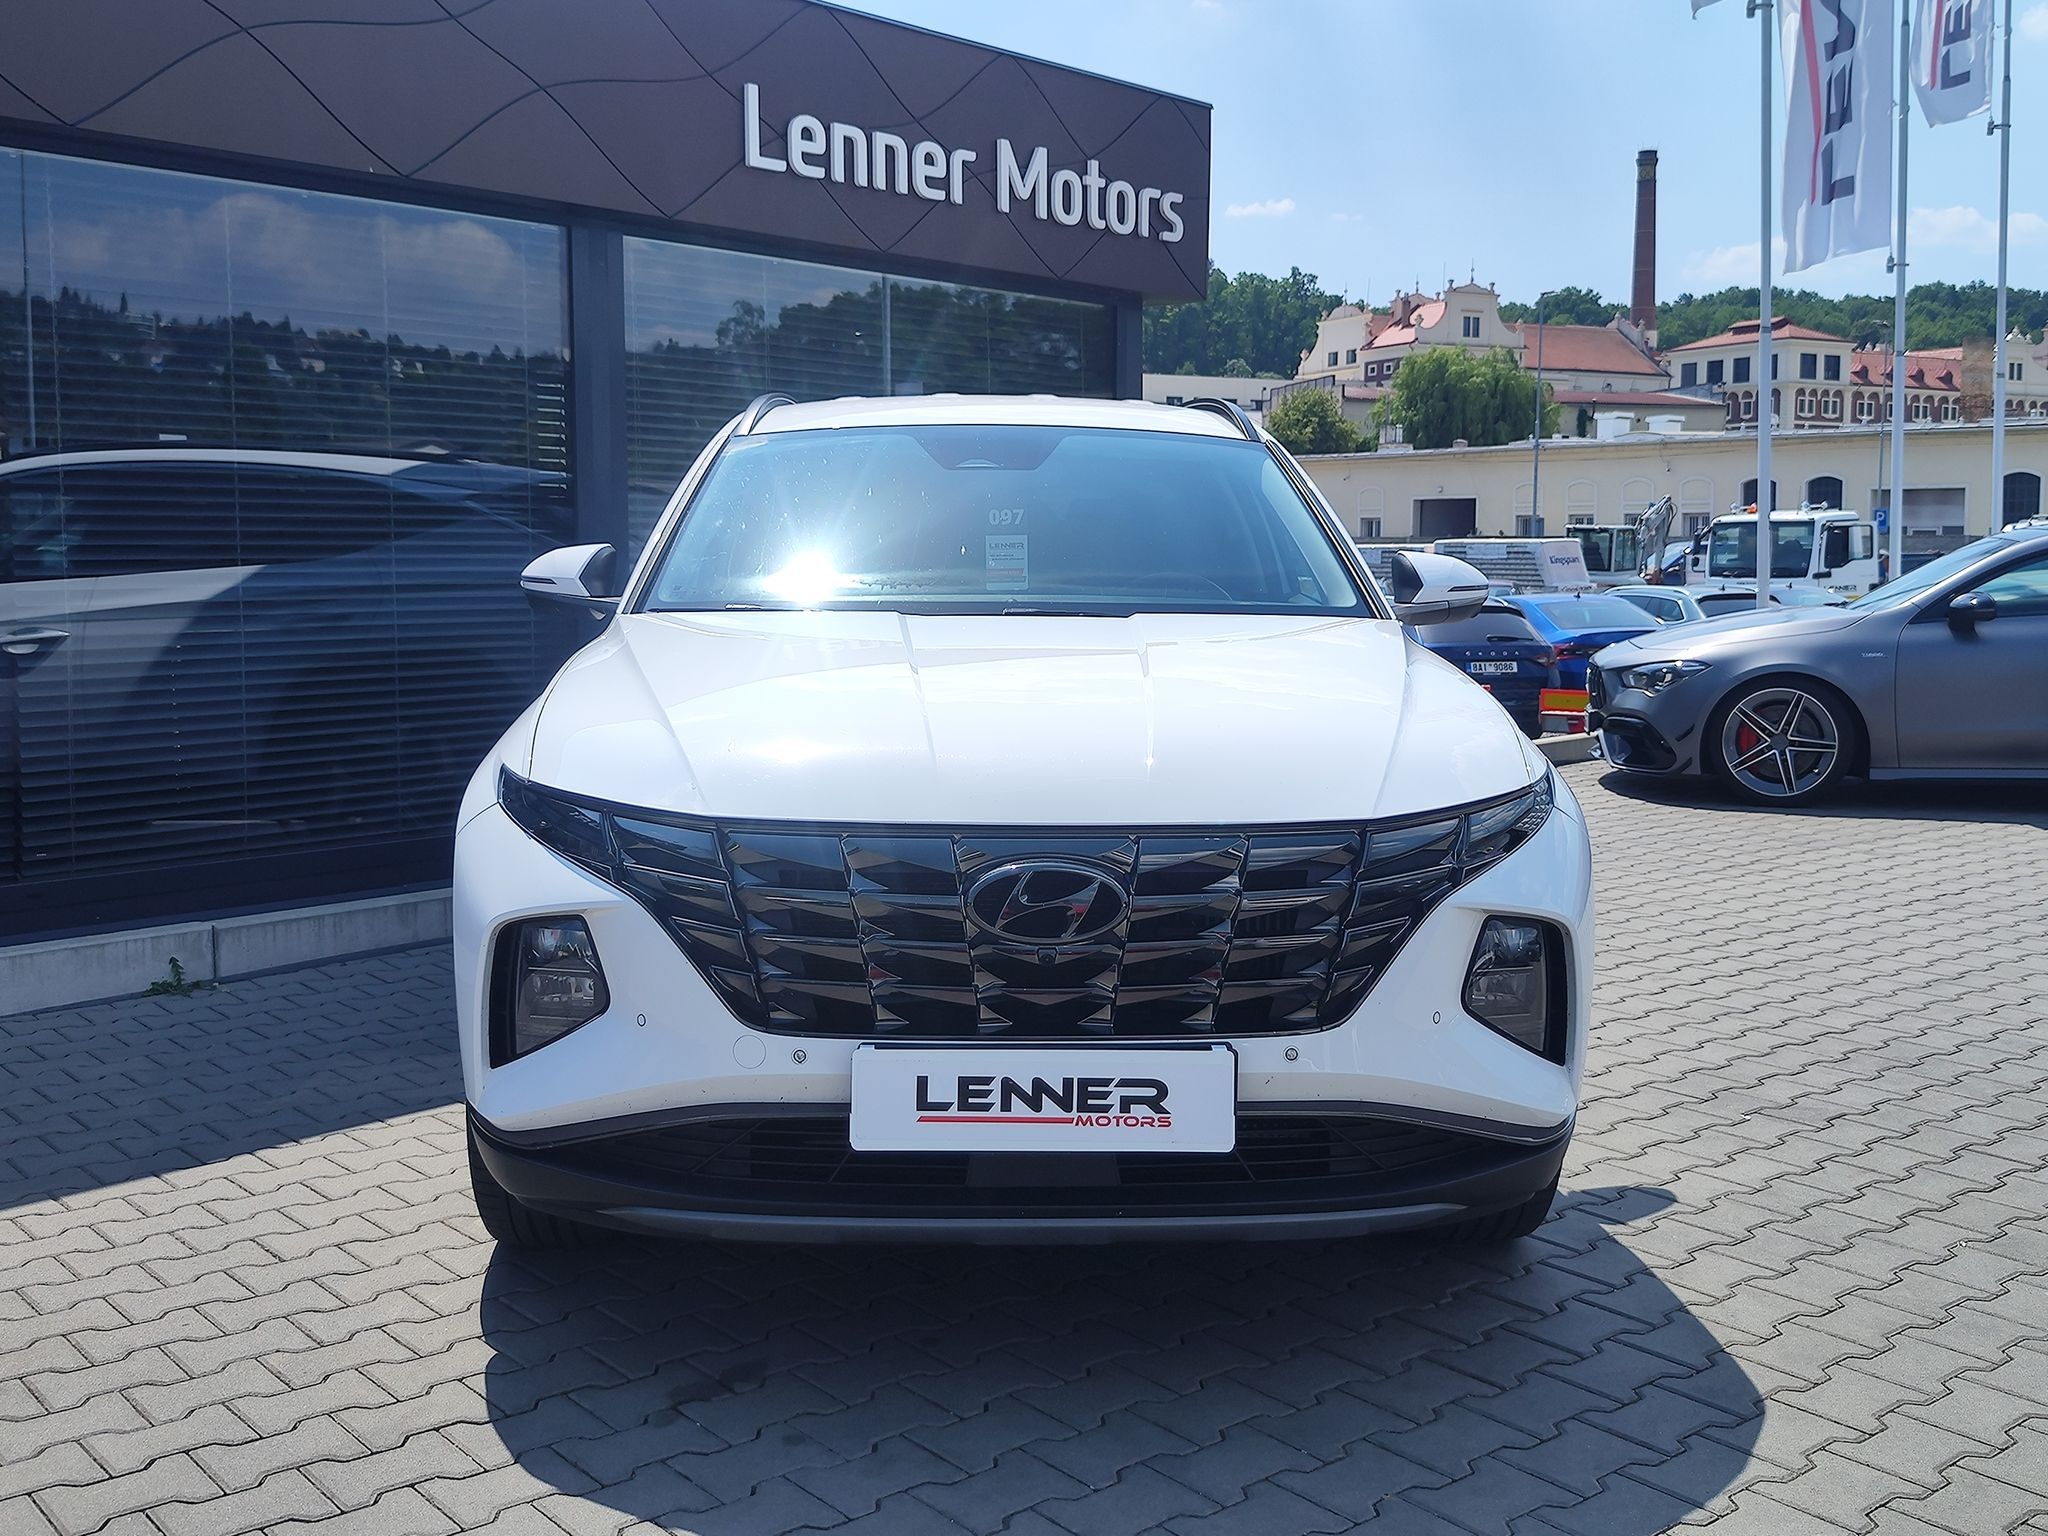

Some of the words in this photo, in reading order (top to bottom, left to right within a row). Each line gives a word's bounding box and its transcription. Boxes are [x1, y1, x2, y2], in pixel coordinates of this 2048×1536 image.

[743, 82, 978, 206] Lenner
[996, 137, 1185, 243] Motors
[989, 508, 1025, 525] 097
[1876, 511, 1885, 523] P
[1472, 662, 1487, 671] 8AI
[1493, 662, 1514, 671] 9086
[915, 1075, 1172, 1115] LENNER
[1074, 1114, 1173, 1128] MOTORS
